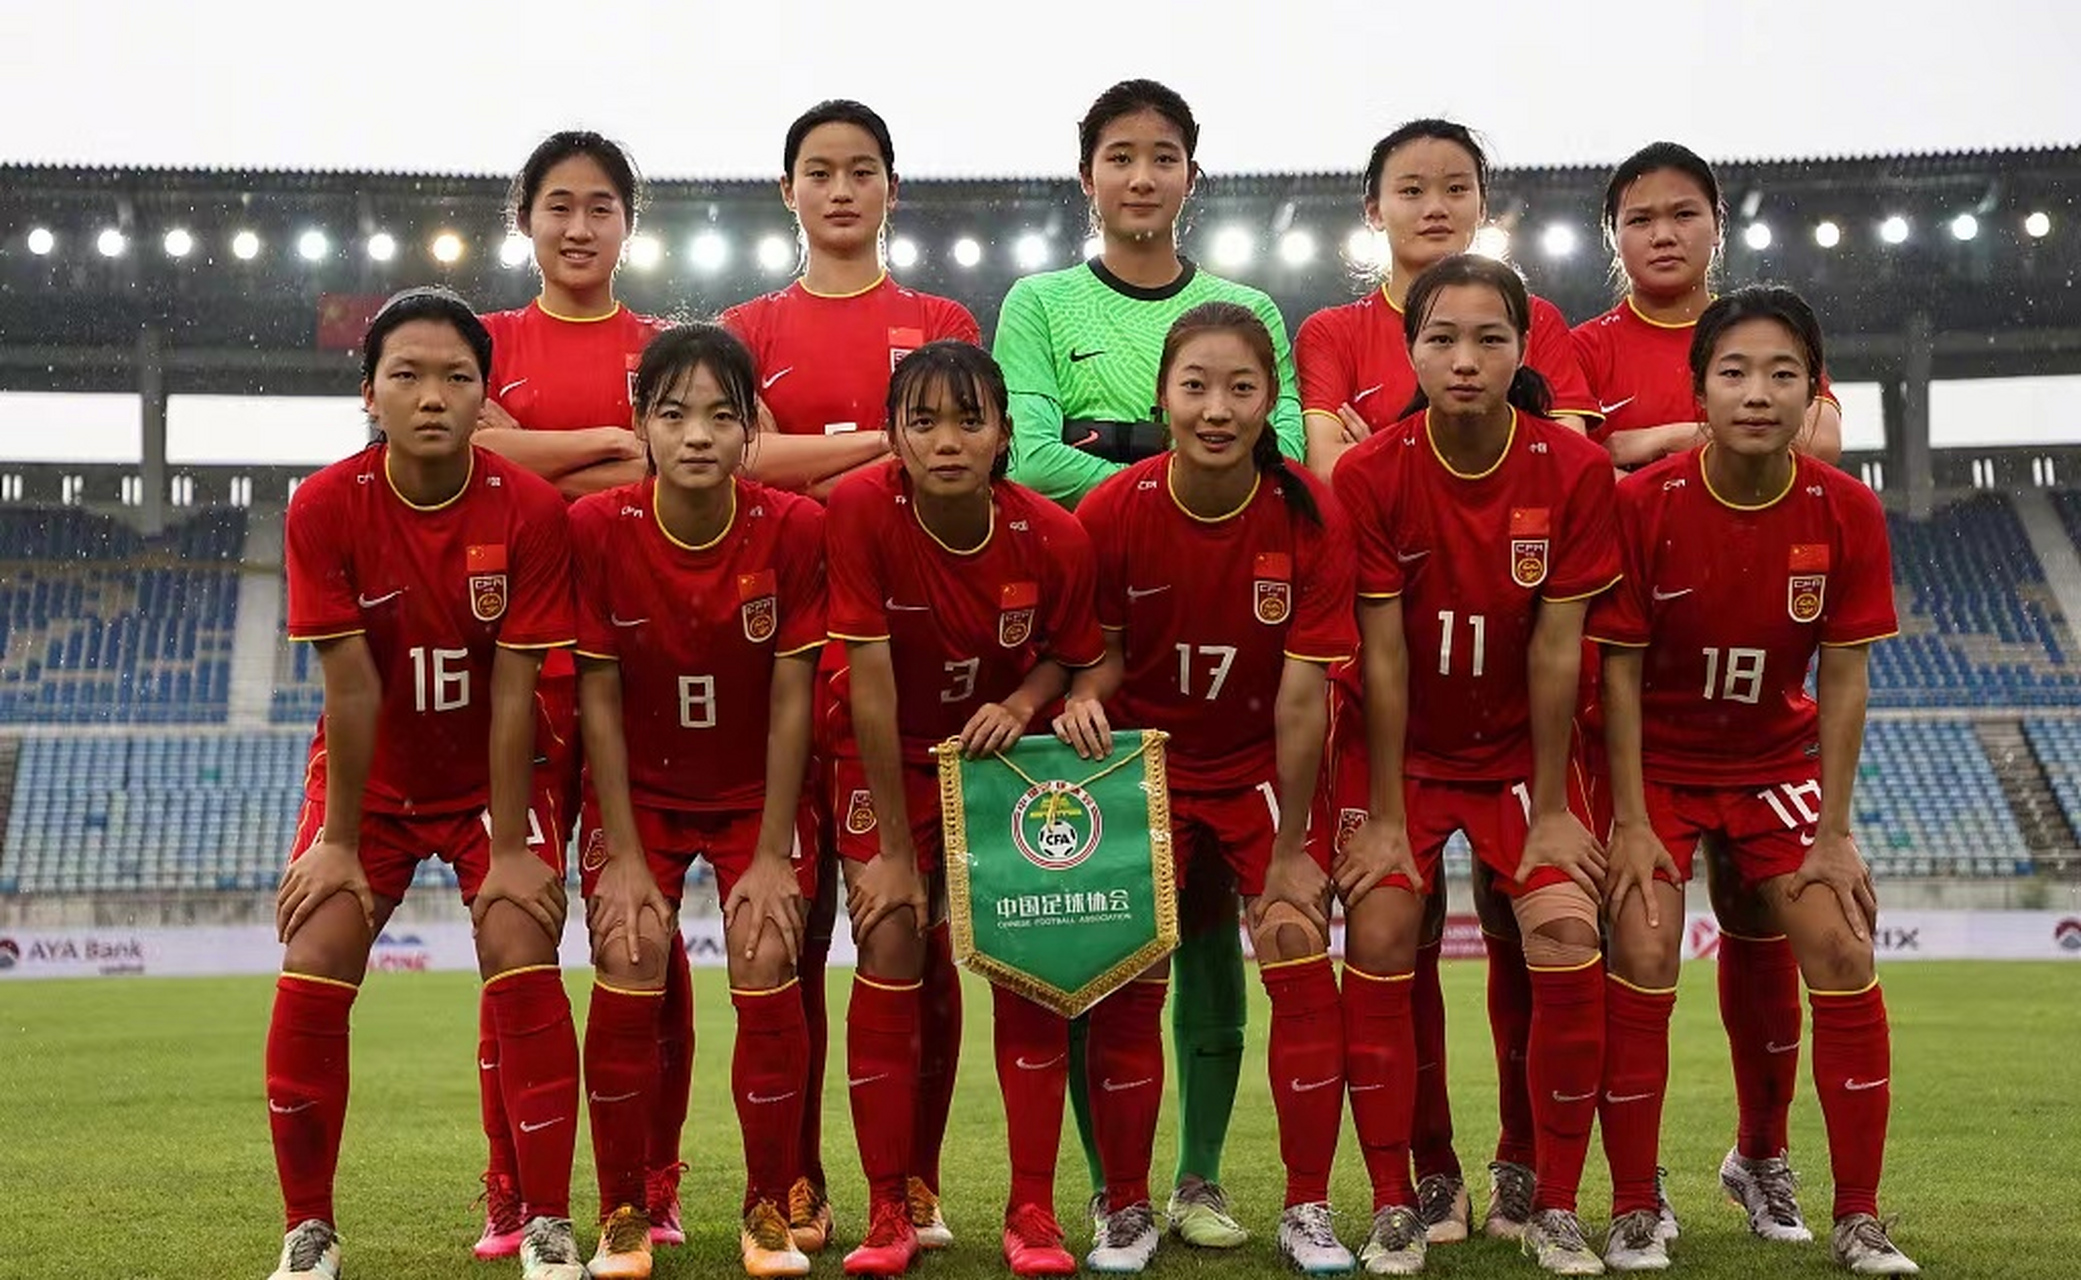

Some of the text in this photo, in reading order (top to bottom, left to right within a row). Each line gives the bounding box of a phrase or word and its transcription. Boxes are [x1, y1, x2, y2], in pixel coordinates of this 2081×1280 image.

[1438, 610, 1485, 677] 11
[410, 647, 469, 711] 16
[941, 657, 980, 703] 3
[1175, 643, 1237, 700] 17
[1702, 647, 1766, 703] 18
[678, 675, 716, 728] 8
[1046, 834, 1071, 846] CFA
[996, 889, 1129, 918] 中国足球协会
[28, 939, 142, 959] AYA Bank
